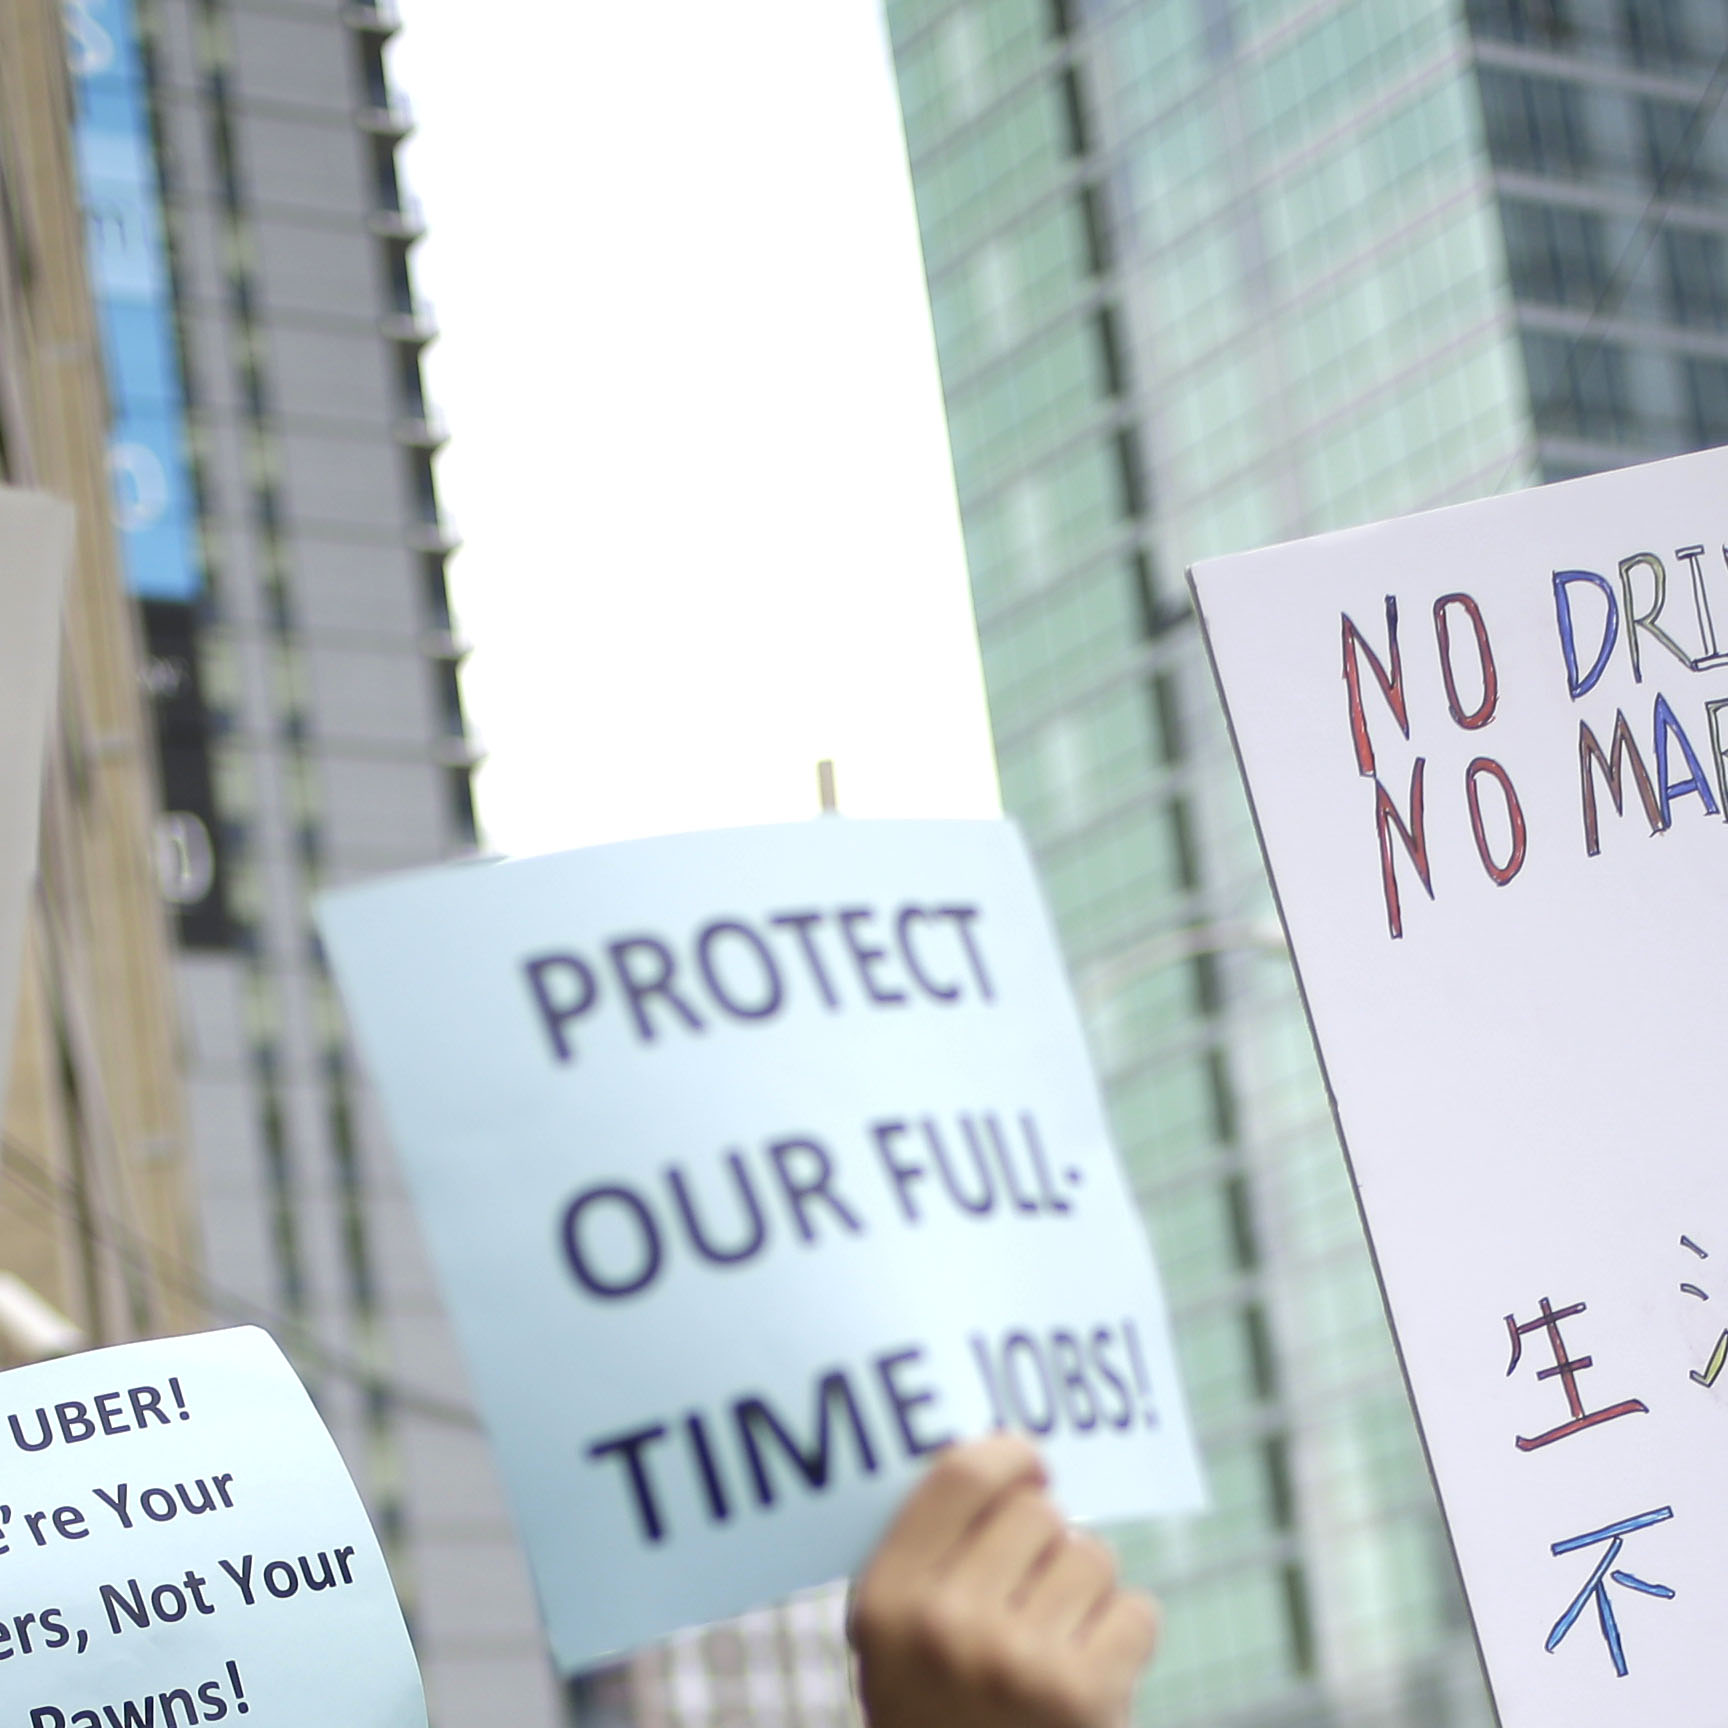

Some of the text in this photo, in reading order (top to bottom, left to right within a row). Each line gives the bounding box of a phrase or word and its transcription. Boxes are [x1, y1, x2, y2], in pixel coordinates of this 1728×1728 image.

[1342, 592, 1499, 778] NO
[1374, 756, 1526, 939] NO
[520, 902, 996, 1065] PROTECT
[558, 1110, 1082, 1302] OUR FULL-
[8, 1377, 191, 1452] UBER!
[93, 1473, 235, 1528] Your
[585, 1319, 1158, 1544] TIME JOBS!
[99, 1570, 215, 1634] Not
[219, 1546, 356, 1605] Your
